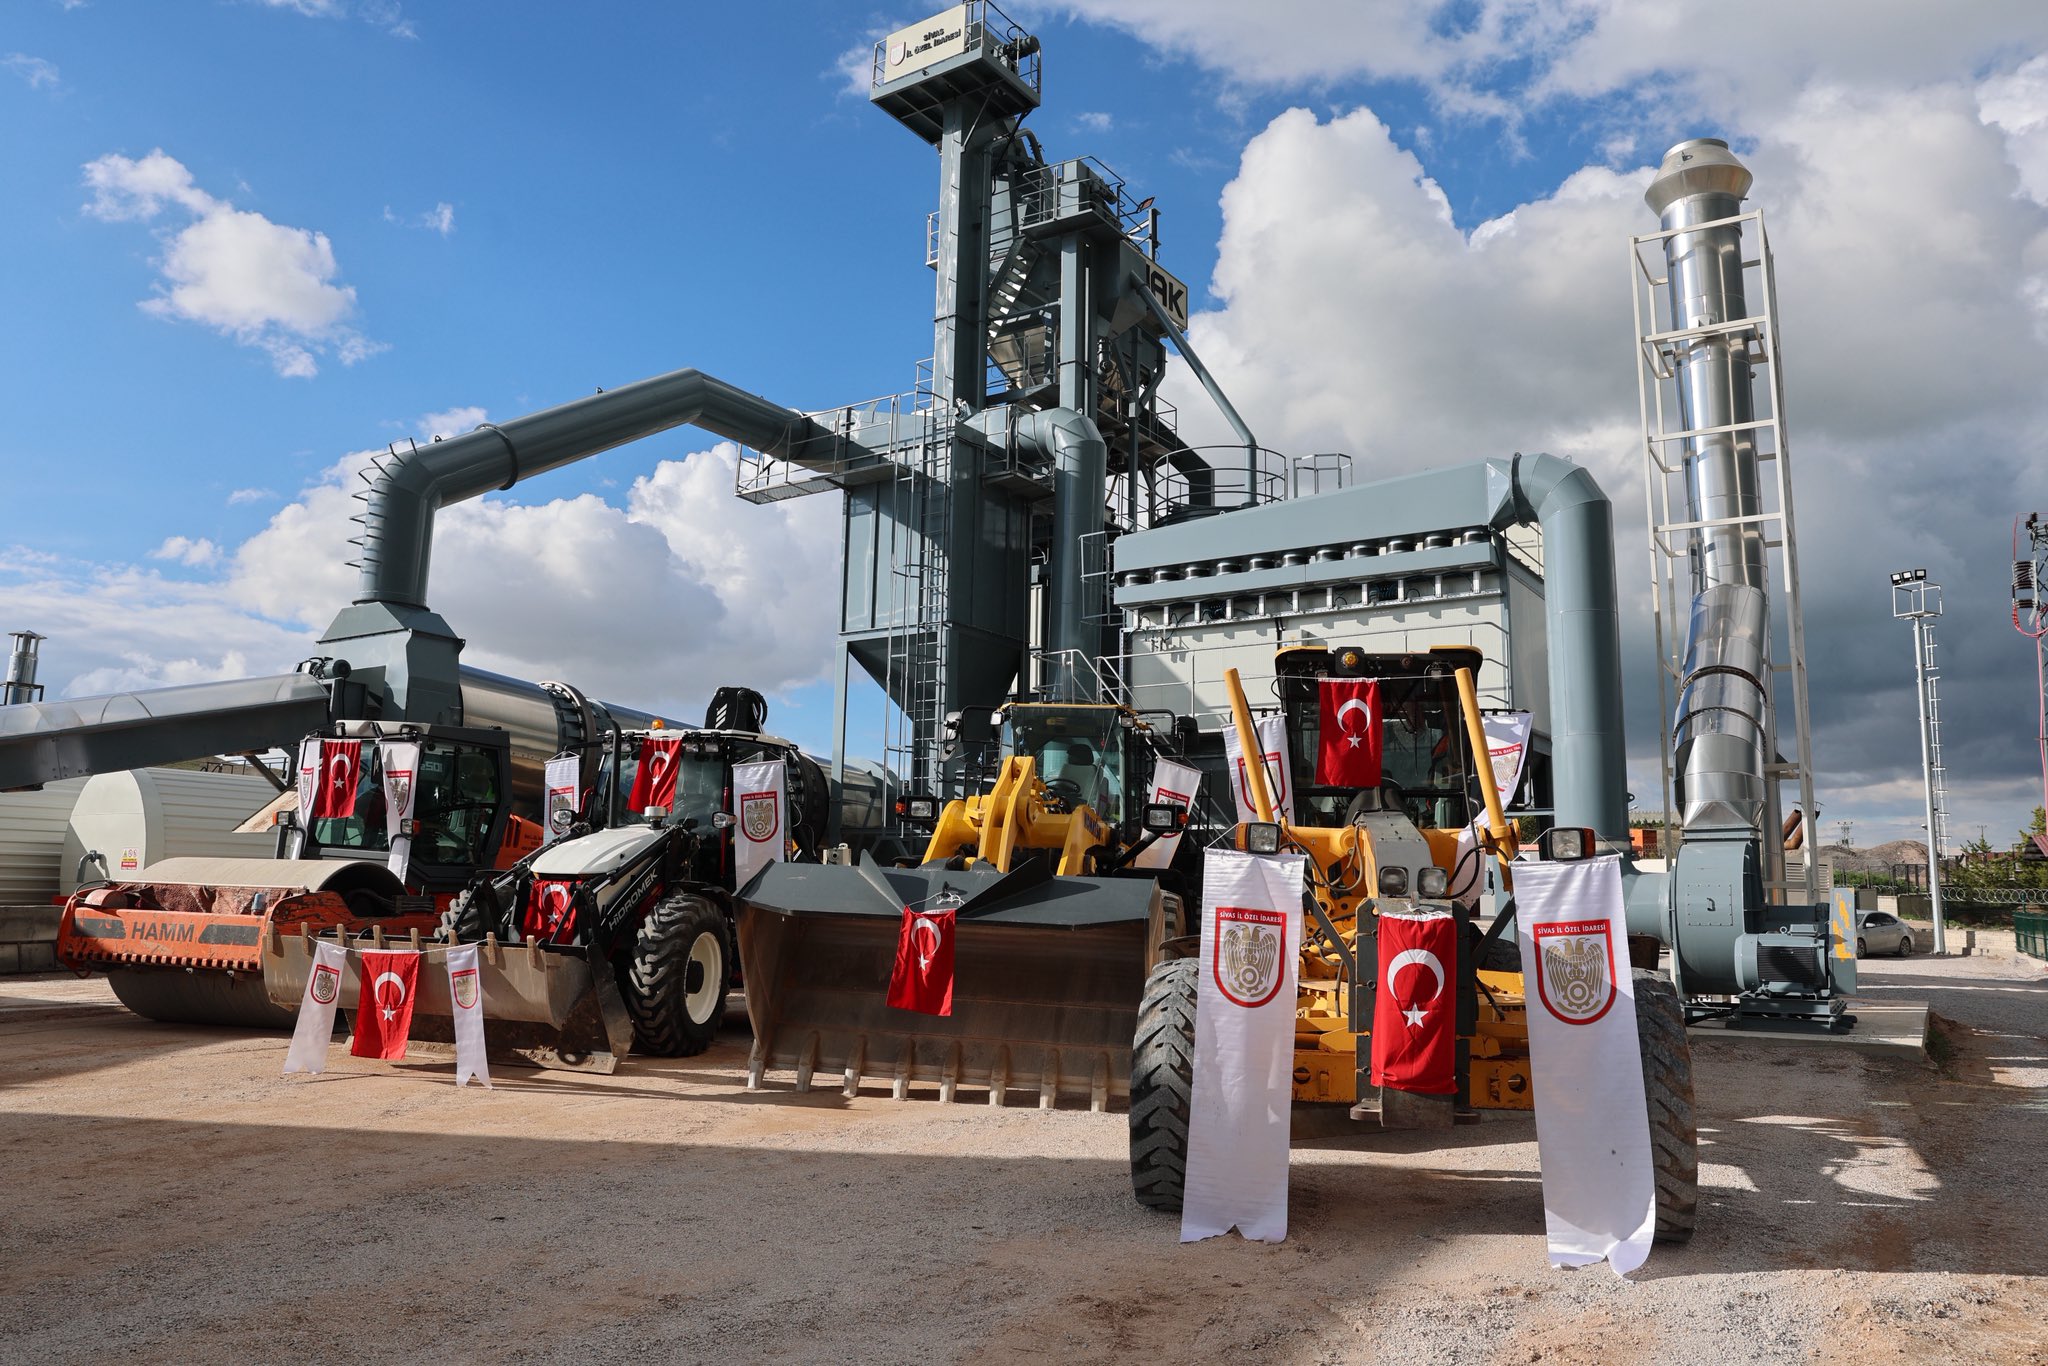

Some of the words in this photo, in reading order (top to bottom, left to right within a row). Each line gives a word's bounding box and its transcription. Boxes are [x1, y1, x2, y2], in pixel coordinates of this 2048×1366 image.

[1146, 263, 1184, 320] AK
[1220, 911, 1235, 919] SİVAS
[1237, 911, 1242, 919] İL
[1244, 912, 1259, 921] ÖZEL
[1260, 914, 1283, 923] İDARESİ
[131, 921, 195, 942] HAMM
[1538, 926, 1555, 934] SİVAS
[1557, 925, 1562, 933] İL
[1564, 925, 1580, 933] ÖZEL
[1582, 923, 1606, 932] İDARESİ
